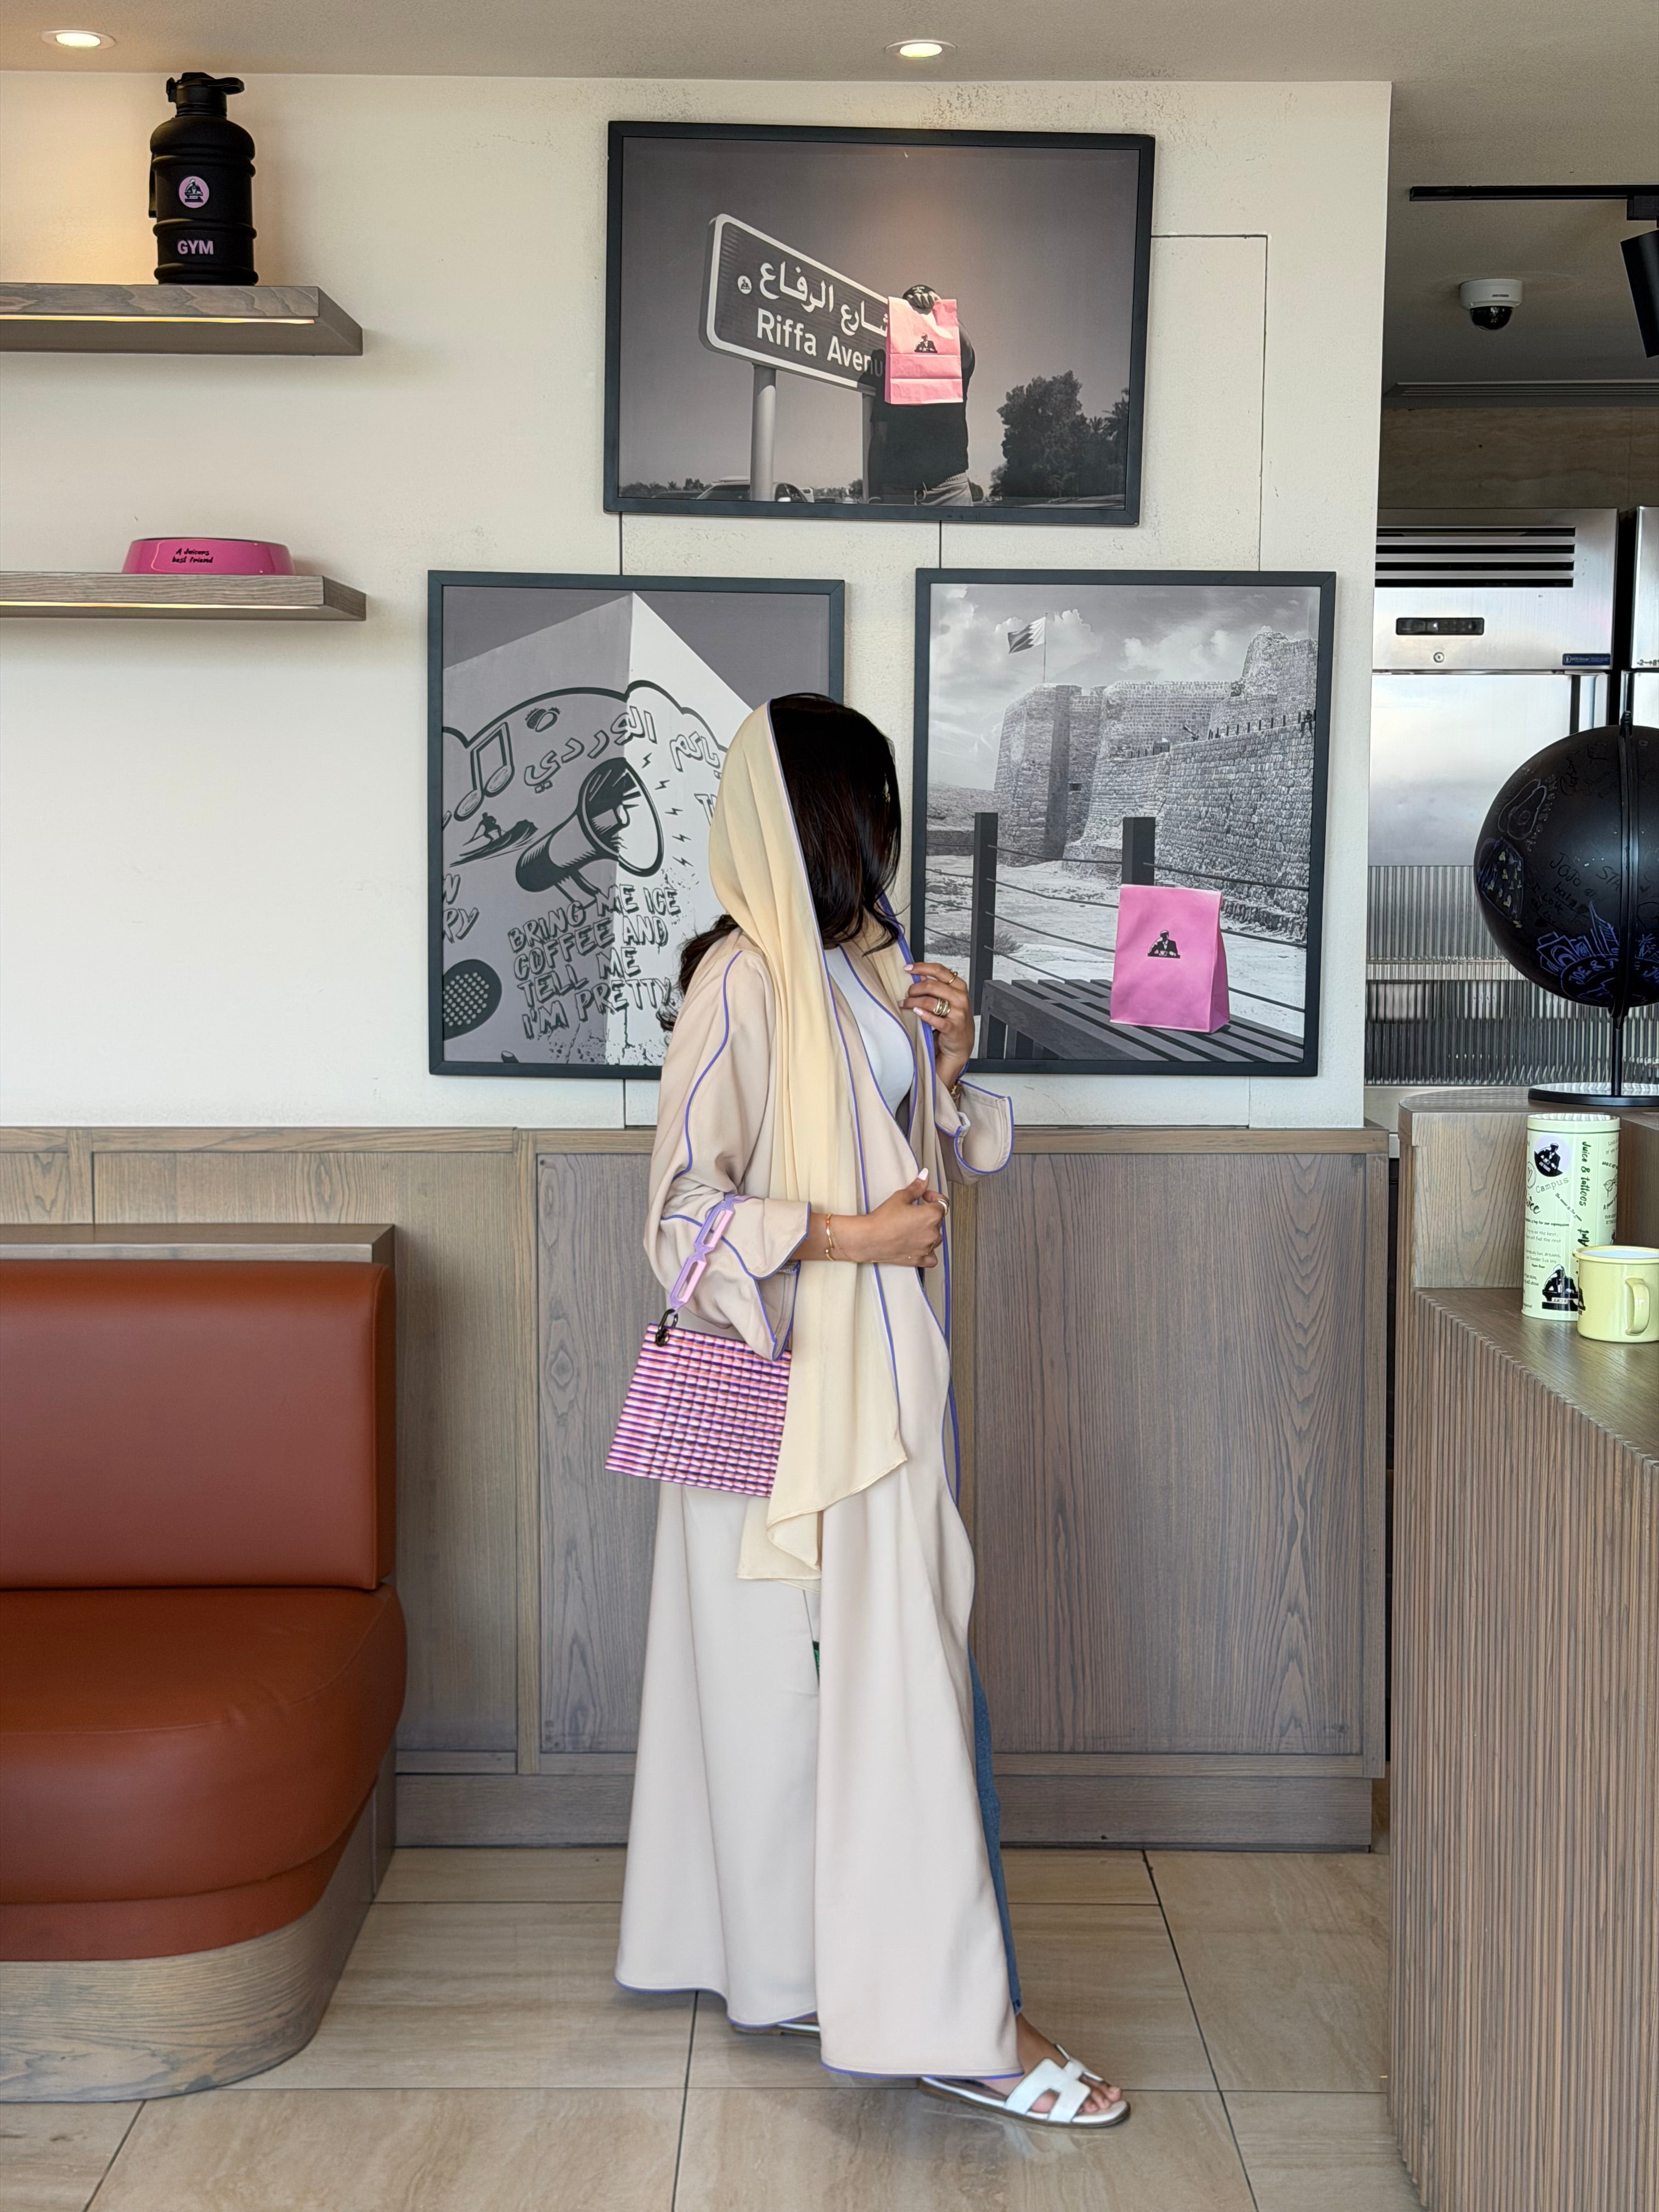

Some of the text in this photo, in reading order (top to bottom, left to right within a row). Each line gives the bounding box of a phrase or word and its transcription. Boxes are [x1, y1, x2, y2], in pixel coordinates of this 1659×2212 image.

[177, 240, 214, 255] GYM
[759, 261, 833, 312] الرفاع
[757, 307, 817, 357] Riffa
[524, 706, 657, 793] الوردي
[508, 884, 681, 953] BRING ME ICE
[514, 916, 669, 980] COFFEE AND
[517, 947, 641, 1007] TELL ME
[522, 978, 672, 1040] I'M PRETTY
[1582, 1141, 1592, 1163] Juice
[1536, 1177, 1570, 1193] Campus
[1579, 1176, 1590, 1207] tattoos
